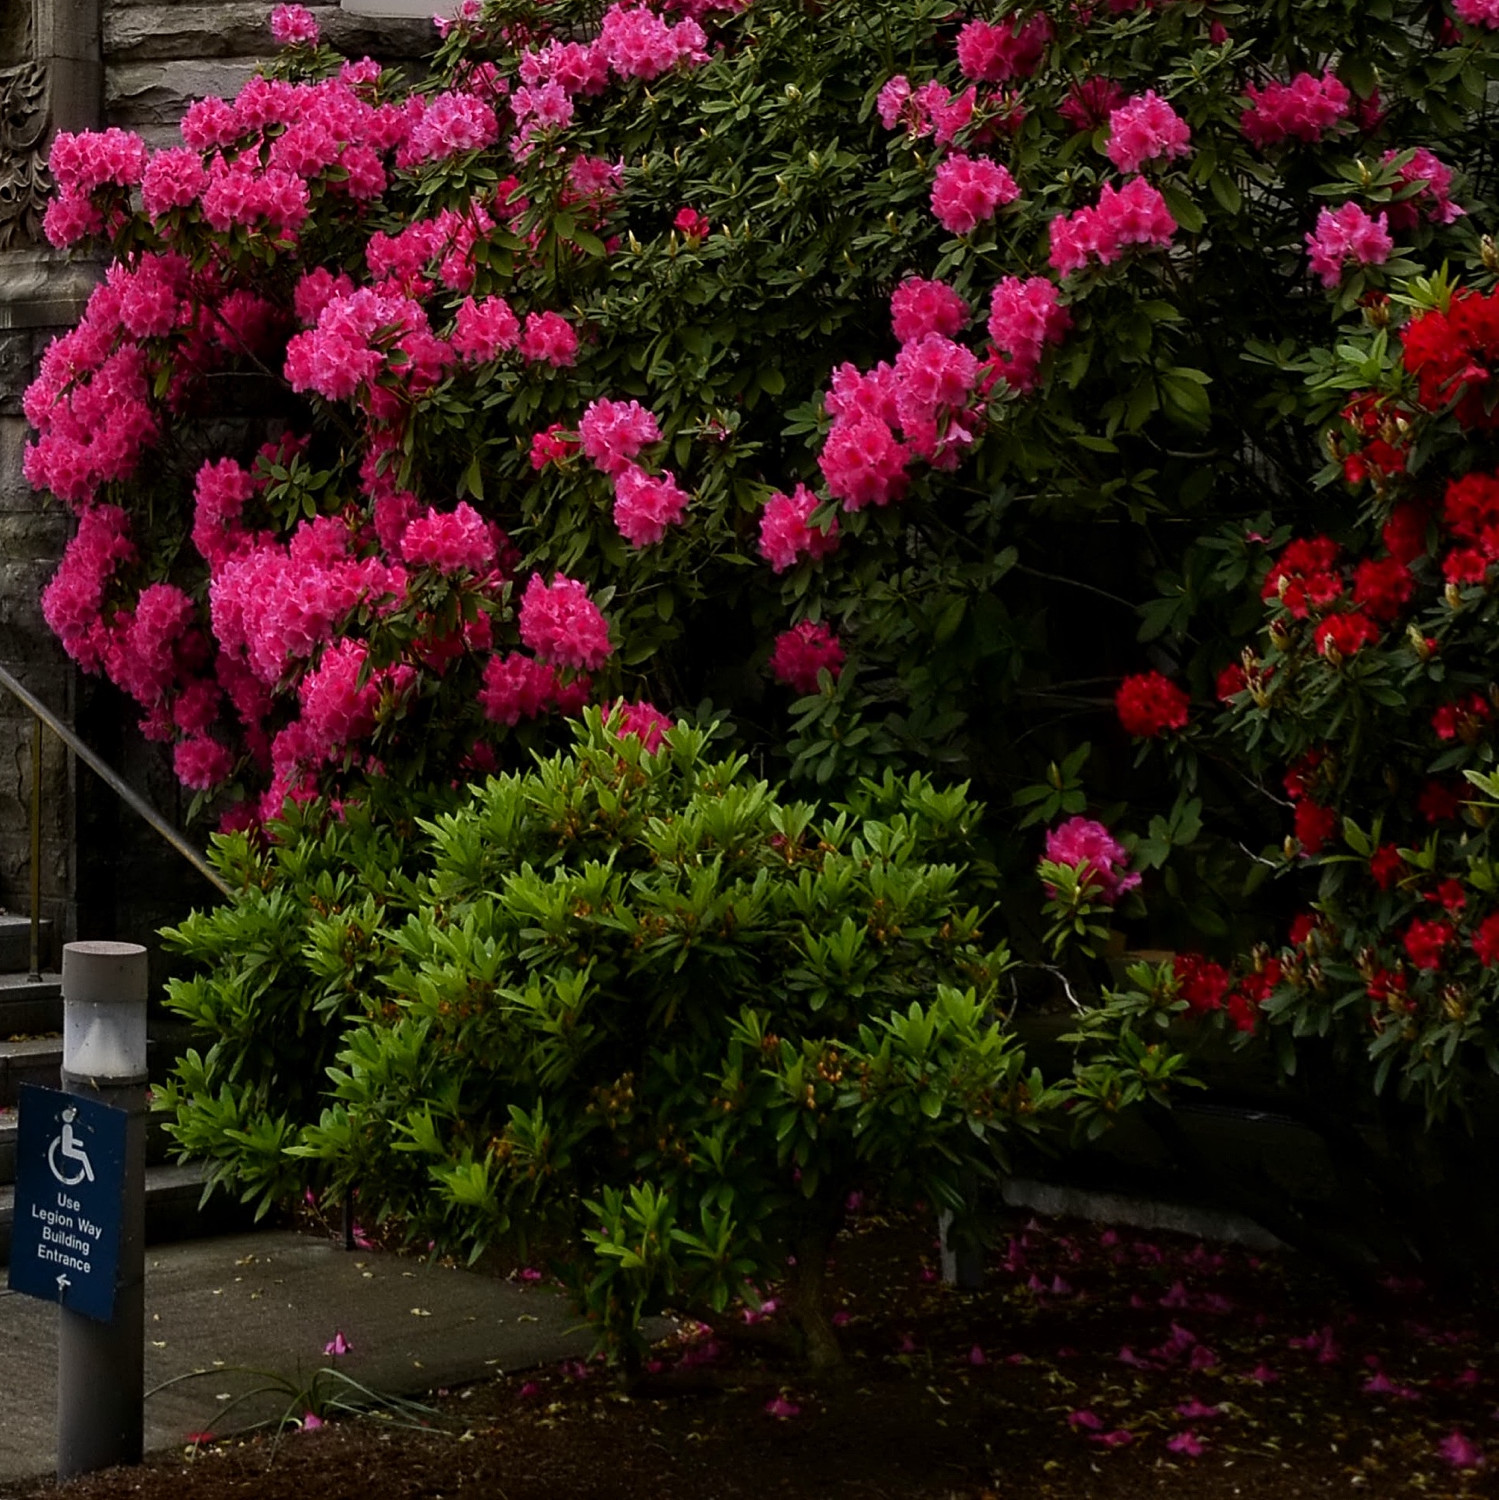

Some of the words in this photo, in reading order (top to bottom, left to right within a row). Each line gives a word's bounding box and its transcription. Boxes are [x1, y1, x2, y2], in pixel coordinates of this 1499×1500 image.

[57, 1192, 80, 1212] Use
[31, 1203, 73, 1228] Legion
[78, 1217, 102, 1240] Way
[42, 1226, 90, 1256] Building
[37, 1243, 91, 1273] Entrance
